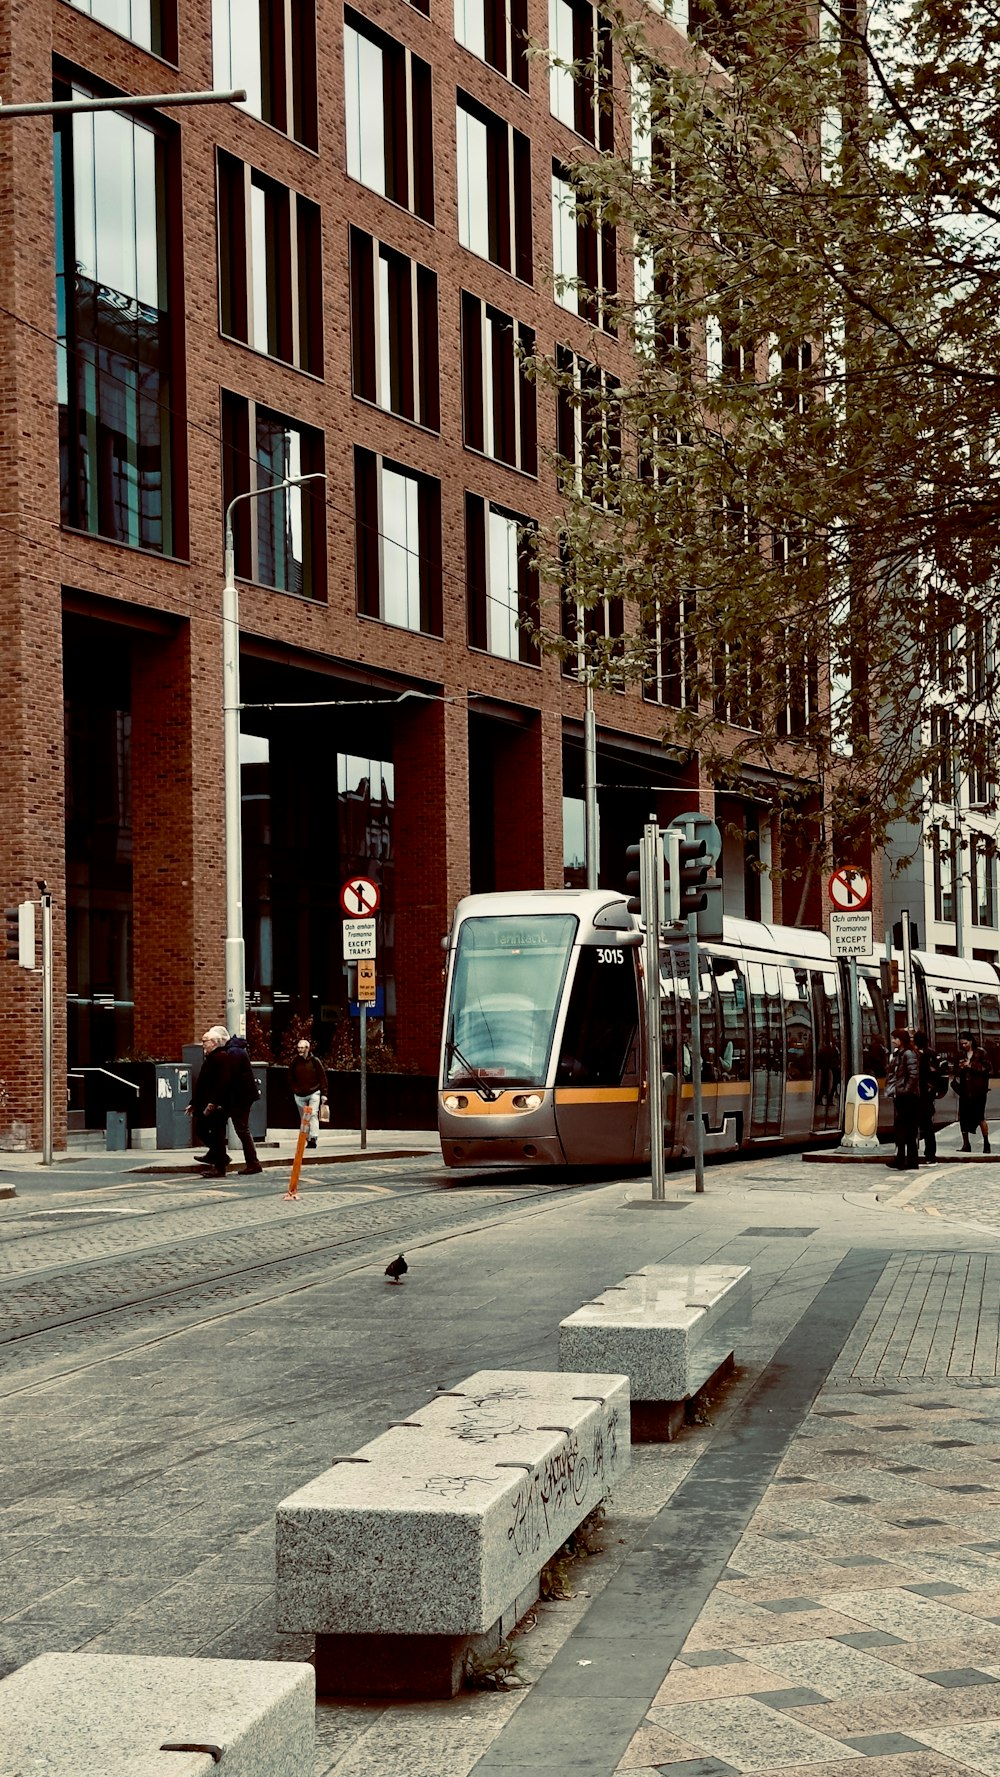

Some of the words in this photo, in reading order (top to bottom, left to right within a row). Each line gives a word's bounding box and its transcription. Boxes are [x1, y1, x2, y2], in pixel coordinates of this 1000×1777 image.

[835, 935, 867, 944] EXCEPT
[348, 940, 372, 948] EXCEPT
[837, 945, 867, 953] TRAMS
[596, 948, 624, 965] 3015
